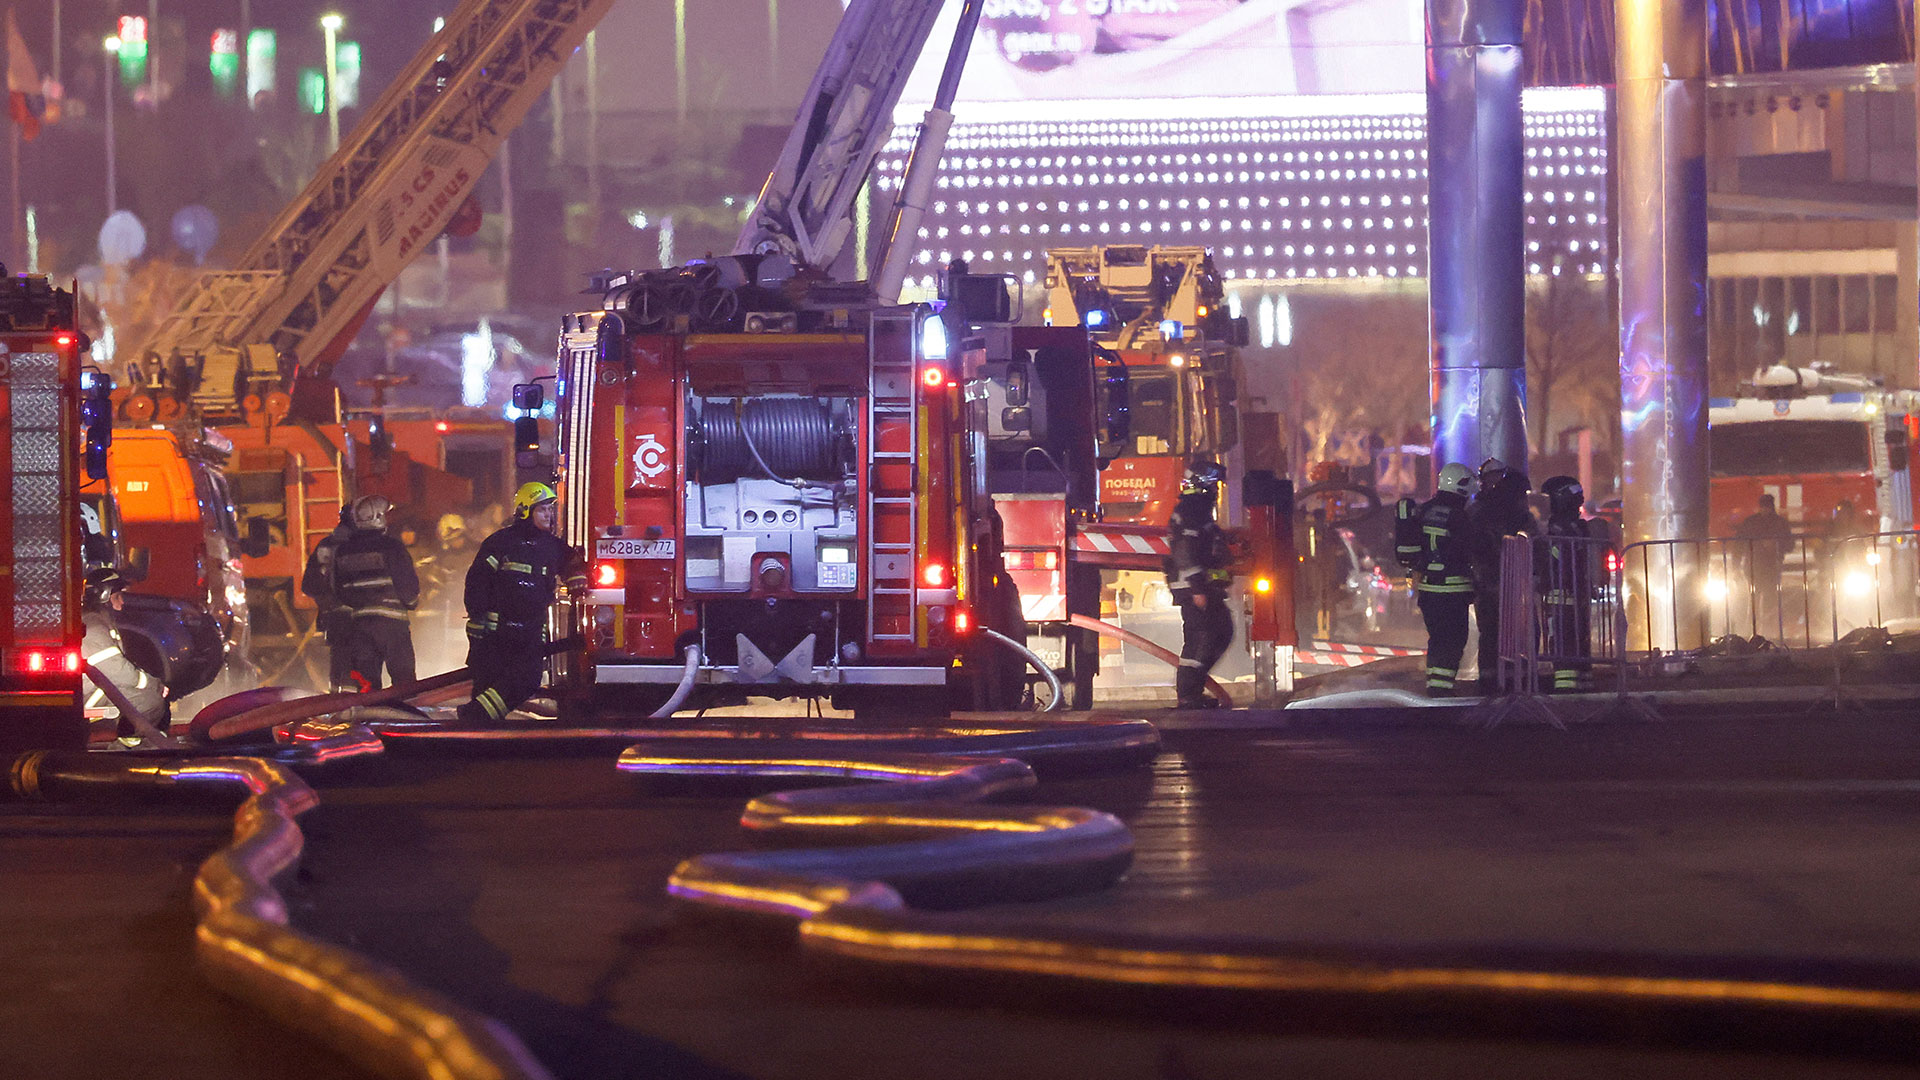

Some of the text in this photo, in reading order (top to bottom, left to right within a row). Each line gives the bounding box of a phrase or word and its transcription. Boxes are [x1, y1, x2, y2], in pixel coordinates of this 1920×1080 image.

[399, 167, 470, 259] MAGIRUS
[1105, 478, 1156, 489] ПОБЕДА!
[600, 541, 671, 555] М628ВХ 777
